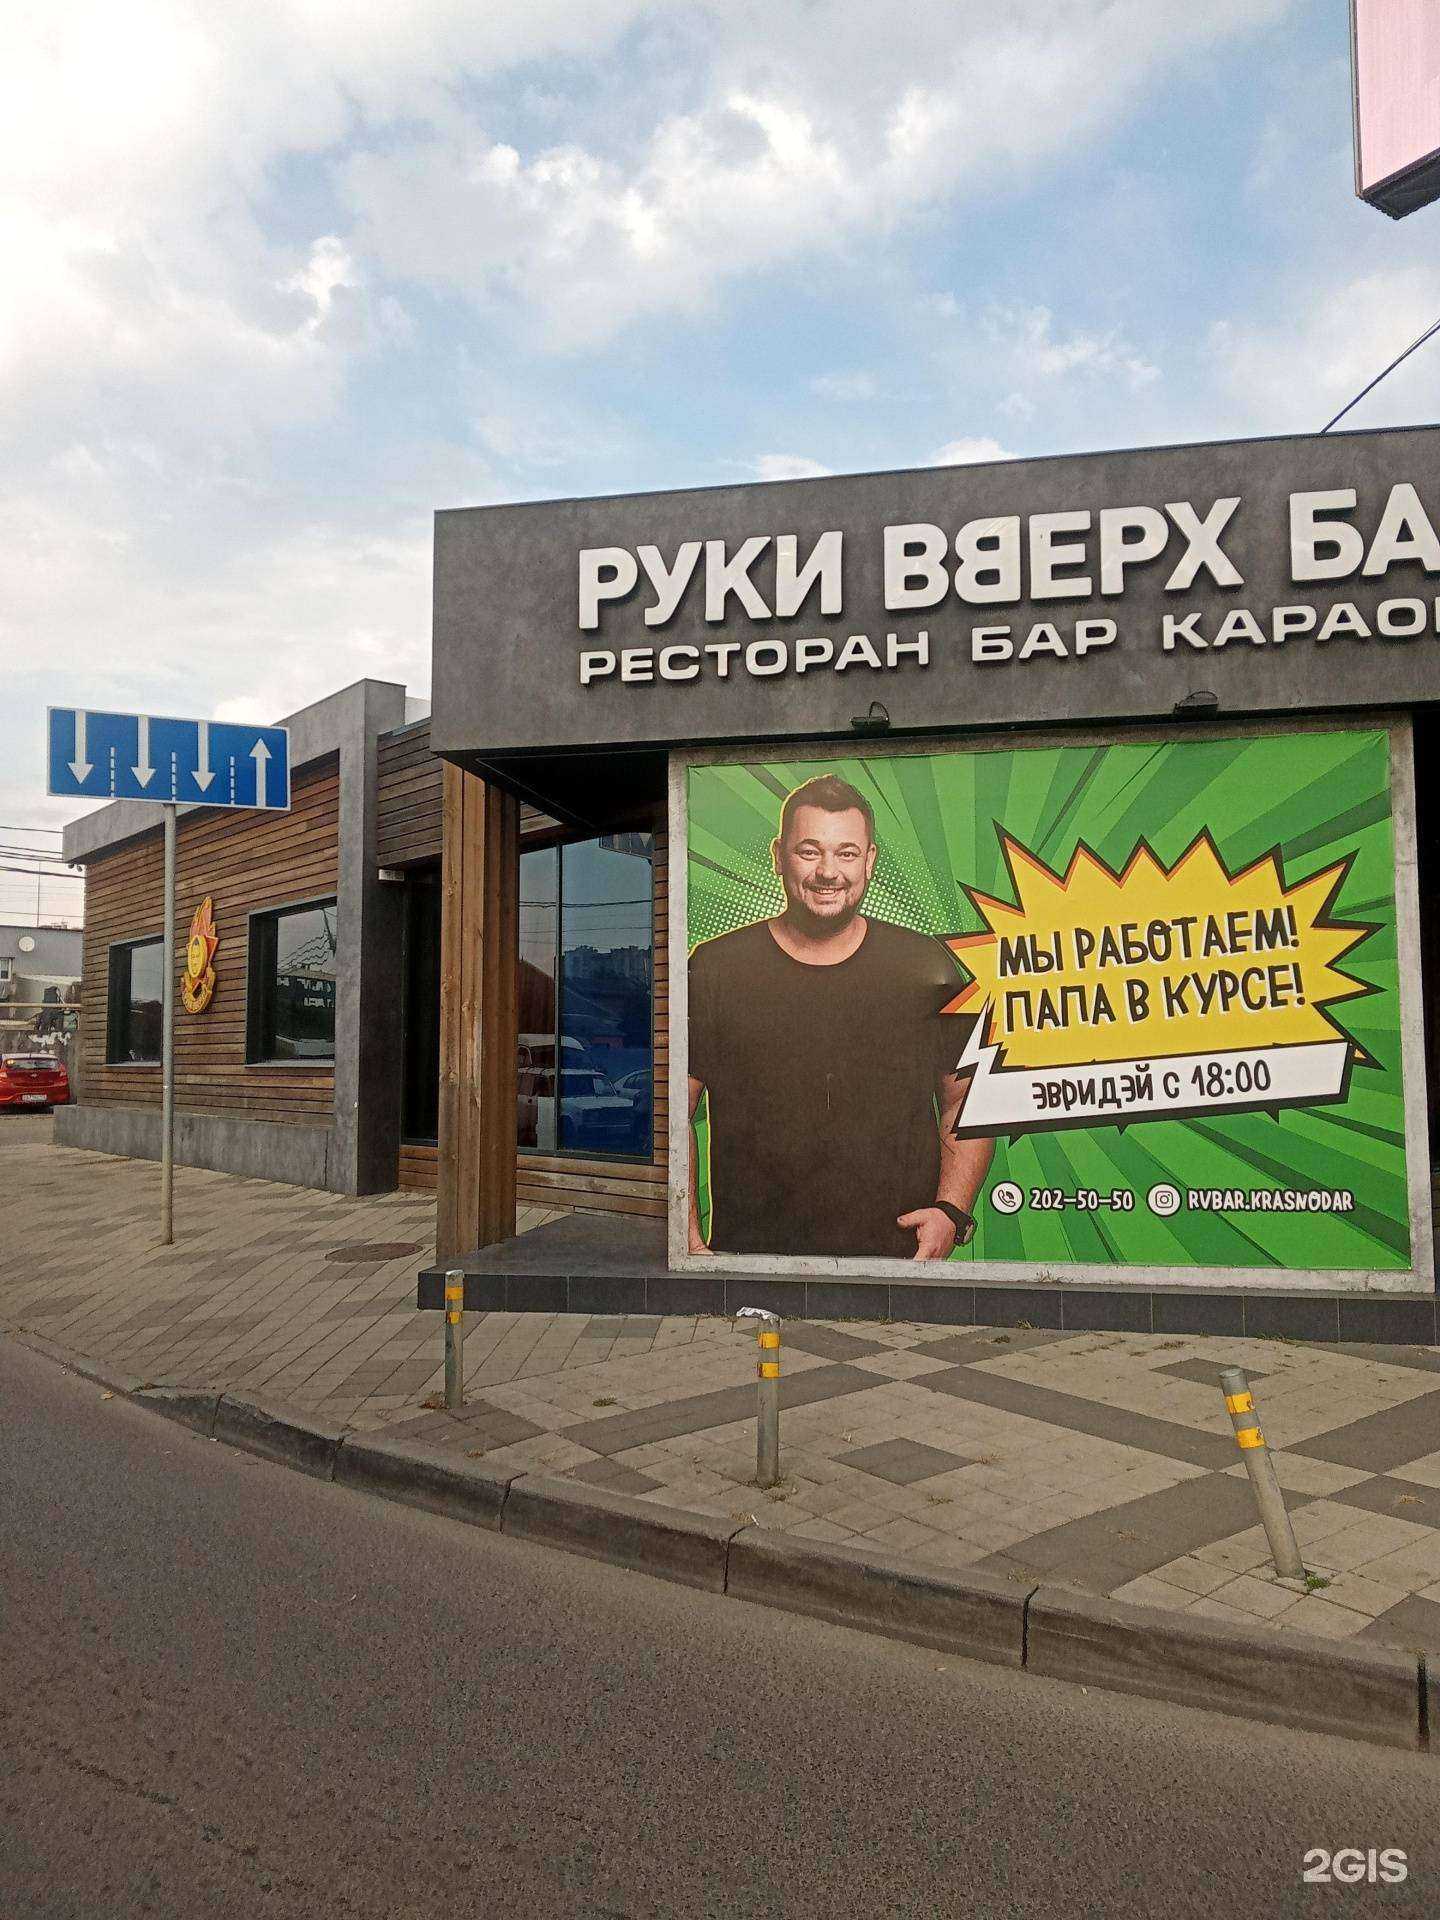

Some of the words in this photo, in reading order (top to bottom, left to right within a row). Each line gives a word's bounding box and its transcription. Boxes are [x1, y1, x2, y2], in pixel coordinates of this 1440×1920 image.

[578, 531, 844, 629] РУКИ
[579, 631, 929, 685] РЕСТОРАН
[970, 618, 1118, 661] БАР
[1162, 597, 1440, 651] КАРАО
[1000, 931, 1064, 977] МЫ
[1074, 904, 1301, 969] РАБОТАЕМ!
[1005, 983, 1116, 1033] ПАПА
[1126, 979, 1150, 1023] В
[1164, 962, 1306, 1018] КУРСЕ!
[1032, 1063, 1153, 1111] ЭВРИДЭЙ
[1163, 1071, 1181, 1099] С
[1191, 1059, 1271, 1097] 18:00
[1030, 1189, 1134, 1211] 202-50-50
[1188, 1189, 1354, 1212] RVBAR.KRASNODAR
